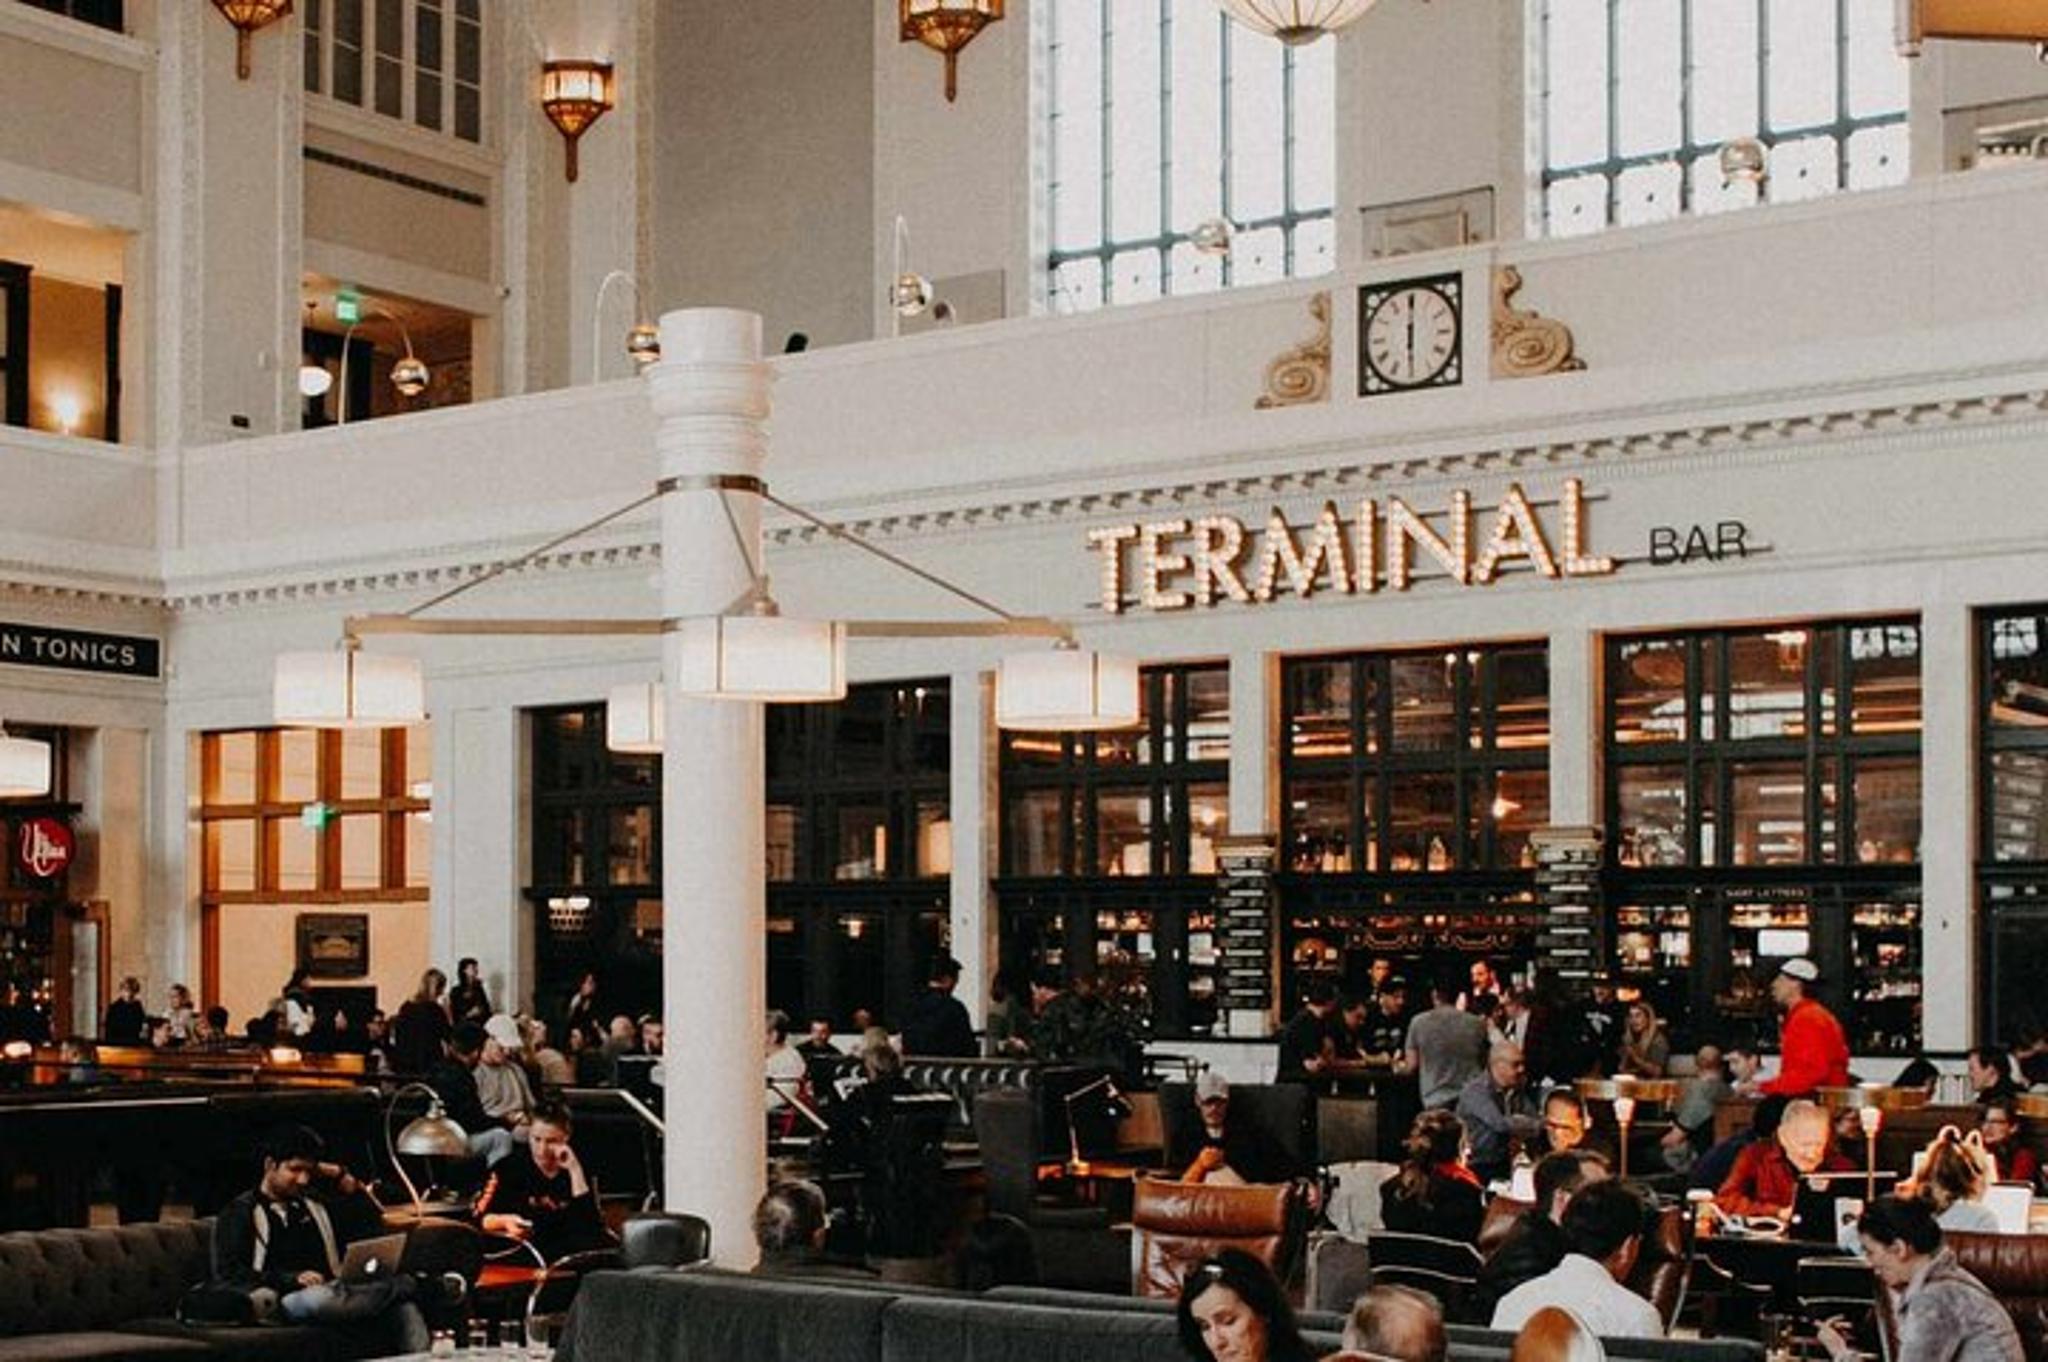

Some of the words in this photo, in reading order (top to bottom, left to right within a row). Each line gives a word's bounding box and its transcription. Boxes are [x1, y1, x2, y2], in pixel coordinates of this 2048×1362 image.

[1087, 477, 1614, 614] TERMINAL
[1650, 520, 1748, 566] BAR
[1, 632, 21, 656] N
[31, 635, 136, 667] TONICS
